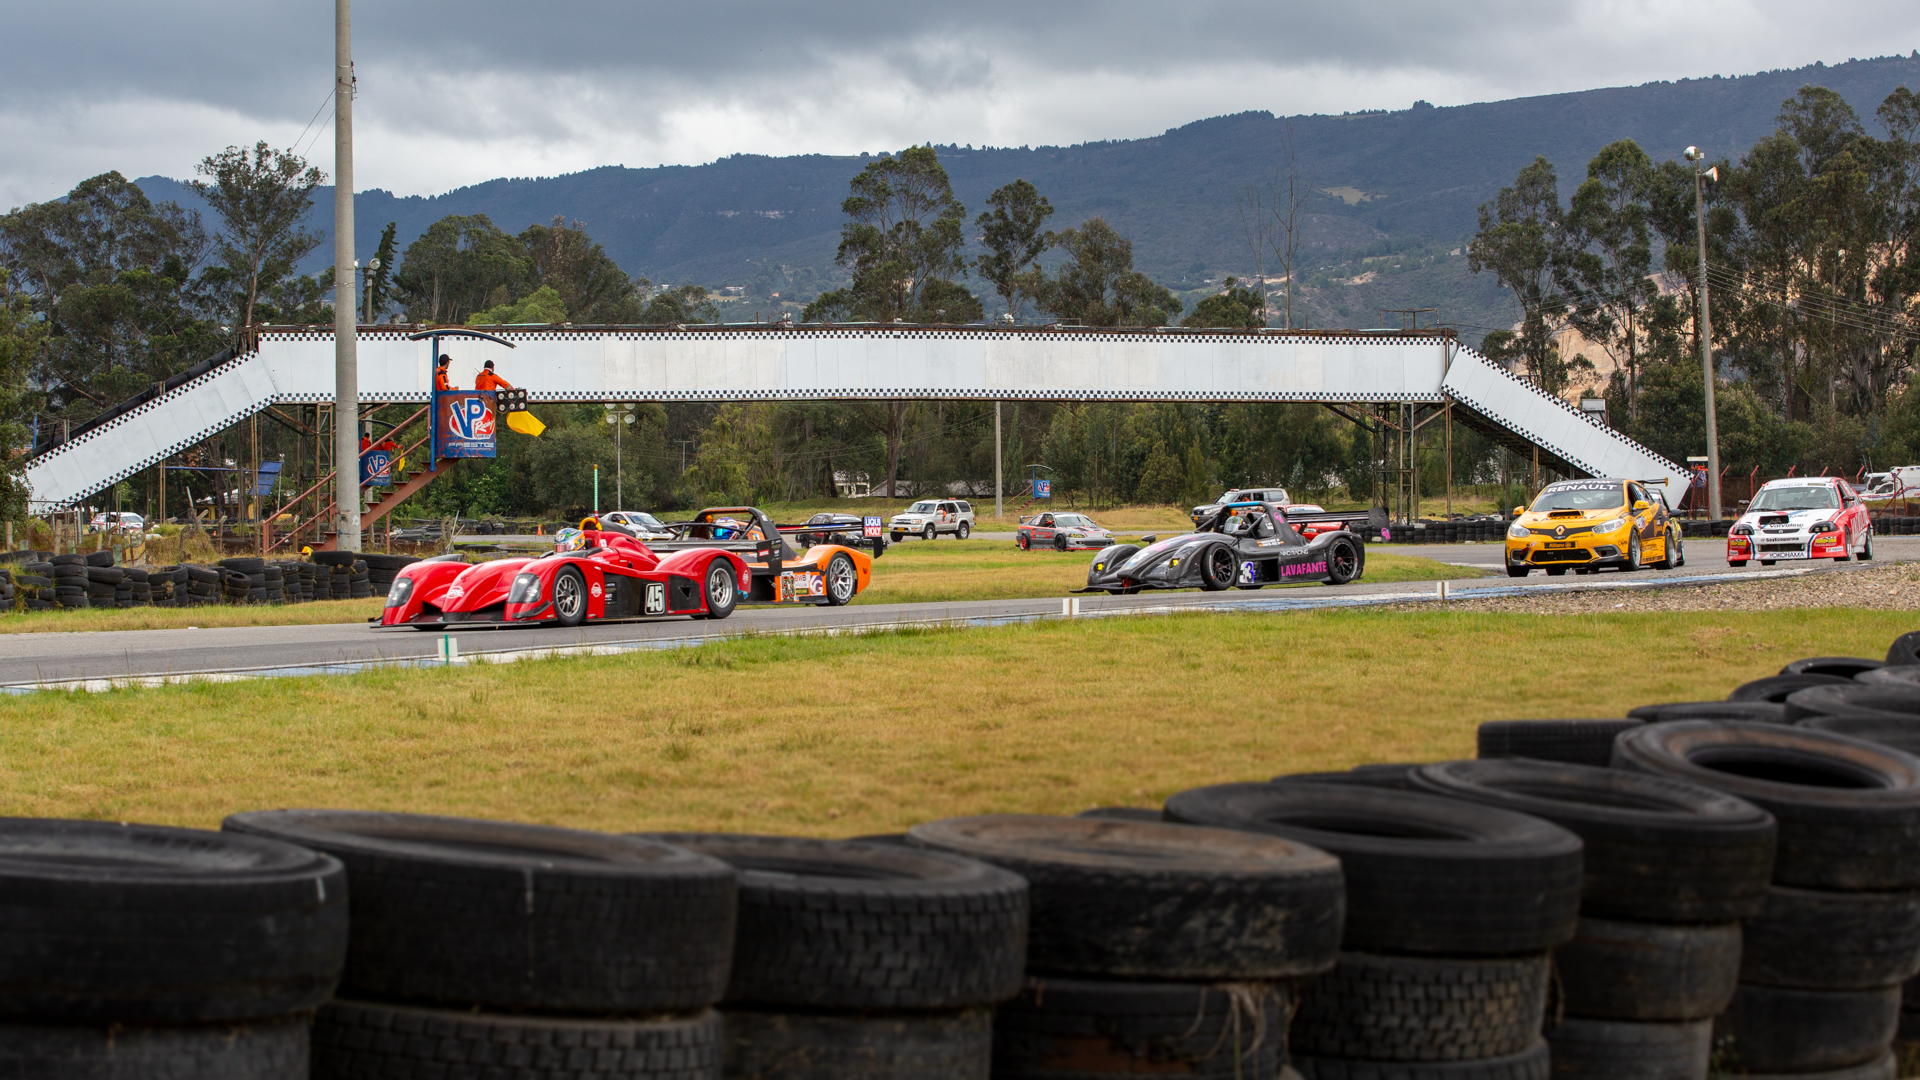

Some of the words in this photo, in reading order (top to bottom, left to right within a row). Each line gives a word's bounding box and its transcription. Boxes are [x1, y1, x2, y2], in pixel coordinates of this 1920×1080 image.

[450, 398, 485, 438] VP
[369, 455, 387, 474] VP
[1038, 481, 1048, 491] VP
[1547, 484, 1617, 493] RENAULT
[866, 517, 881, 526] LIQUI
[866, 527, 881, 536] MOLY
[1281, 561, 1327, 577] LAVAFANTE
[647, 585, 663, 613] 45
